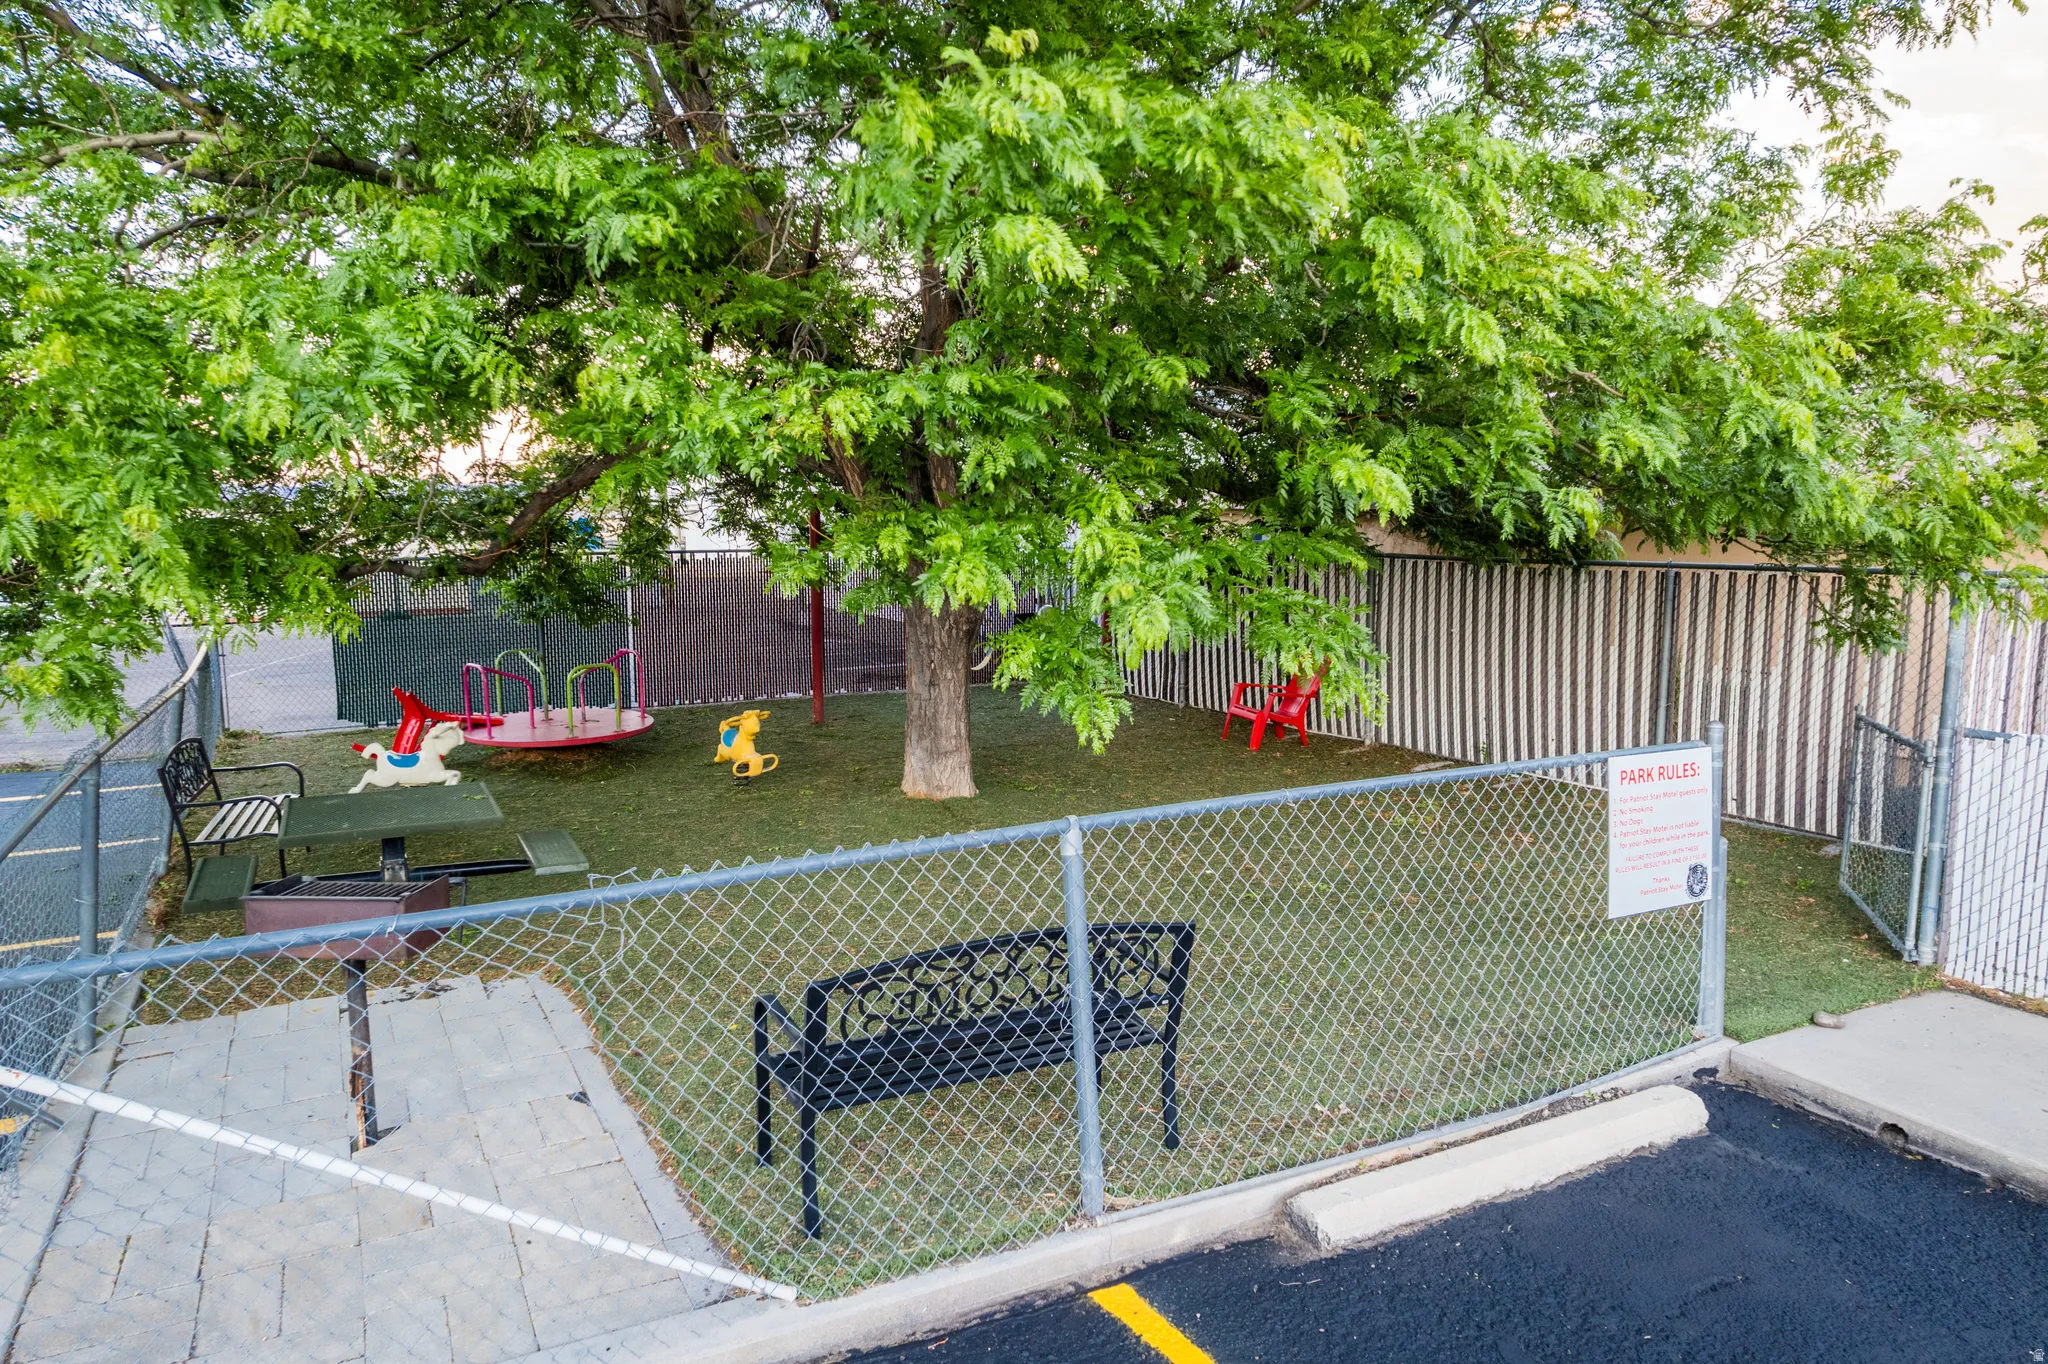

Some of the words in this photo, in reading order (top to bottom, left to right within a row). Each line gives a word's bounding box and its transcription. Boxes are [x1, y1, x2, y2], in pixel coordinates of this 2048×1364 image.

[1620, 767, 1654, 785] PARK
[1658, 762, 1700, 781] RULES:
[1630, 794, 1648, 803] Patriot
[1679, 789, 1695, 798] guests
[1697, 786, 1708, 795] only
